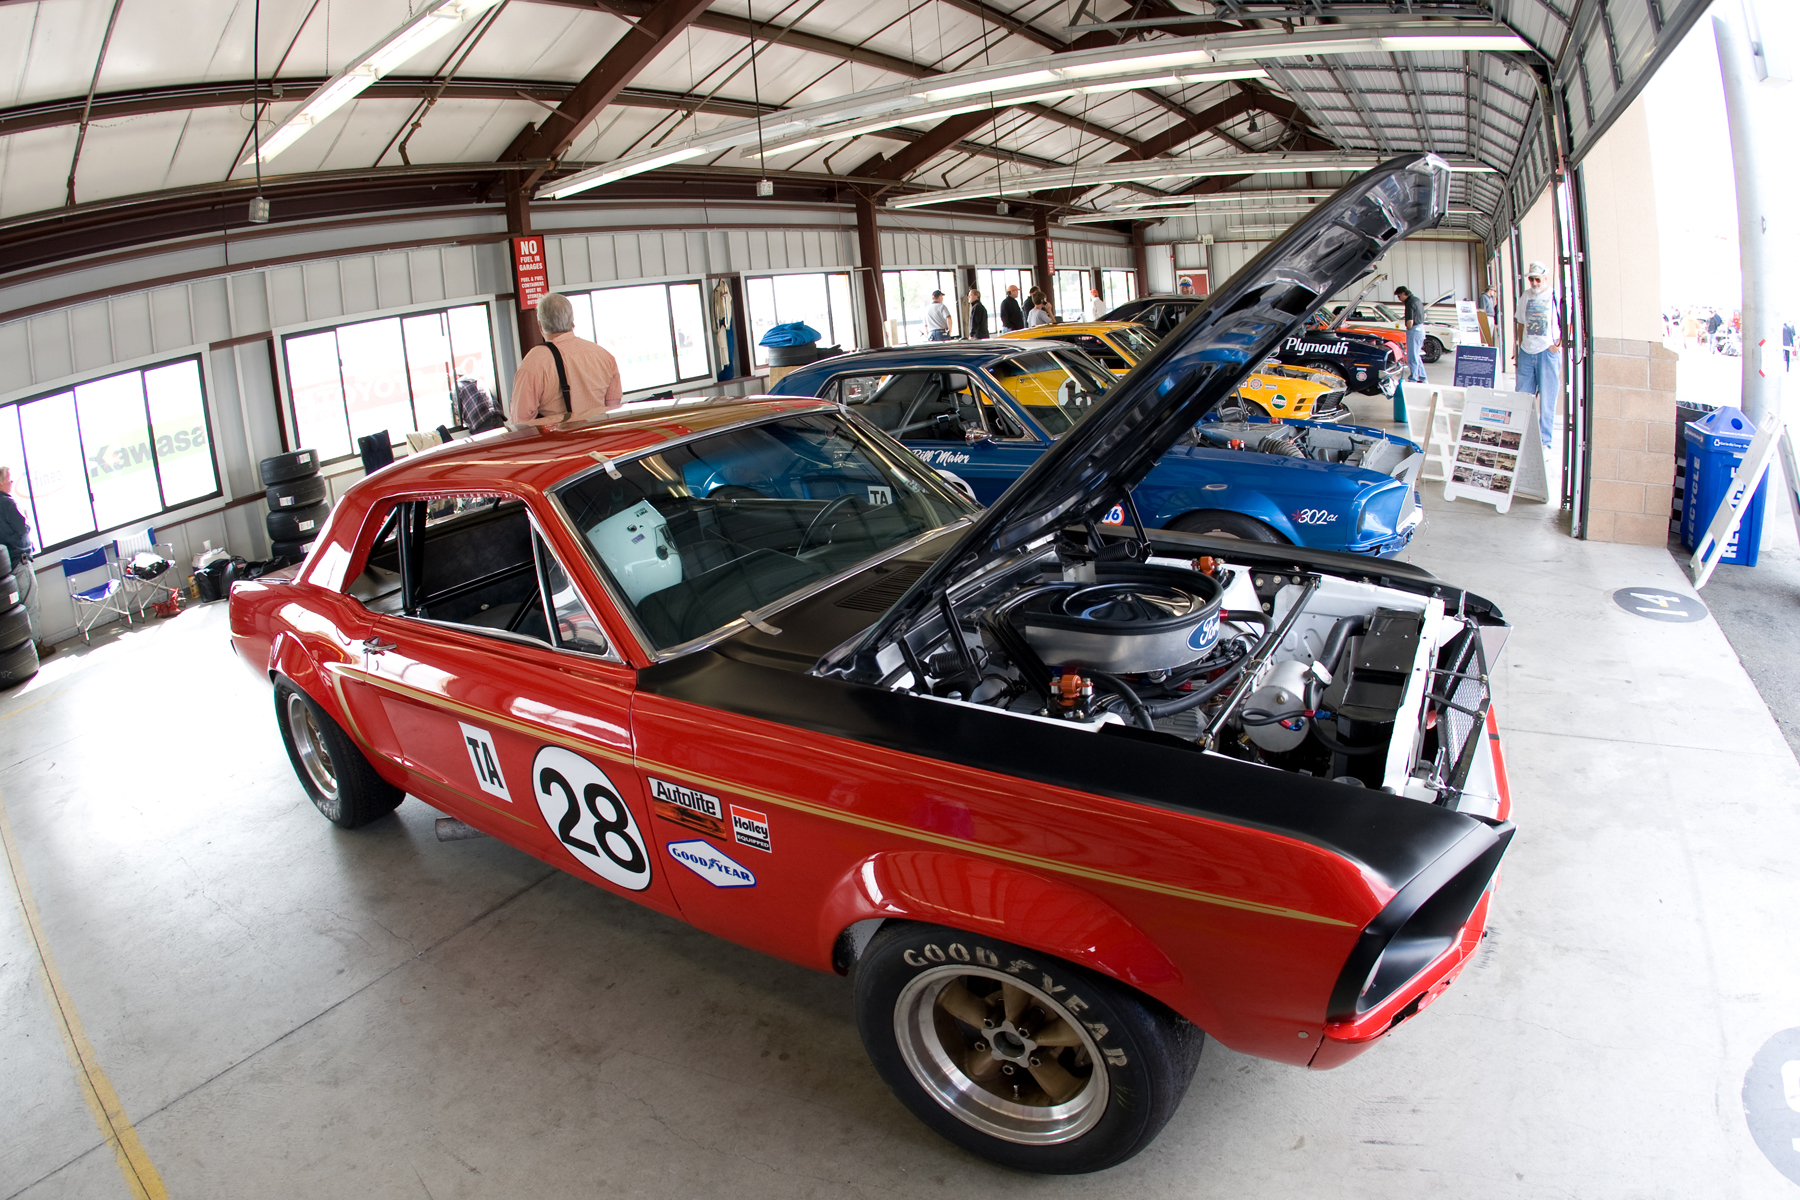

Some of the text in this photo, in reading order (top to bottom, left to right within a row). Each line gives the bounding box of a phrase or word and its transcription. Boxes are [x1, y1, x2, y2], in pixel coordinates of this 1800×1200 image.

[520, 240, 537, 255] NO
[519, 262, 543, 271] GARAGES
[1286, 337, 1349, 355] Plymouth
[935, 450, 970, 467] Maier
[870, 490, 889, 505] TA
[1687, 456, 1701, 547] RECYCLE
[1298, 508, 1328, 525] 302
[1629, 592, 1689, 617] 14
[466, 736, 504, 790] TA
[656, 781, 717, 816] Autolite
[539, 766, 647, 874] 28
[733, 815, 769, 840] Holley
[736, 834, 769, 848] EQUIPPED
